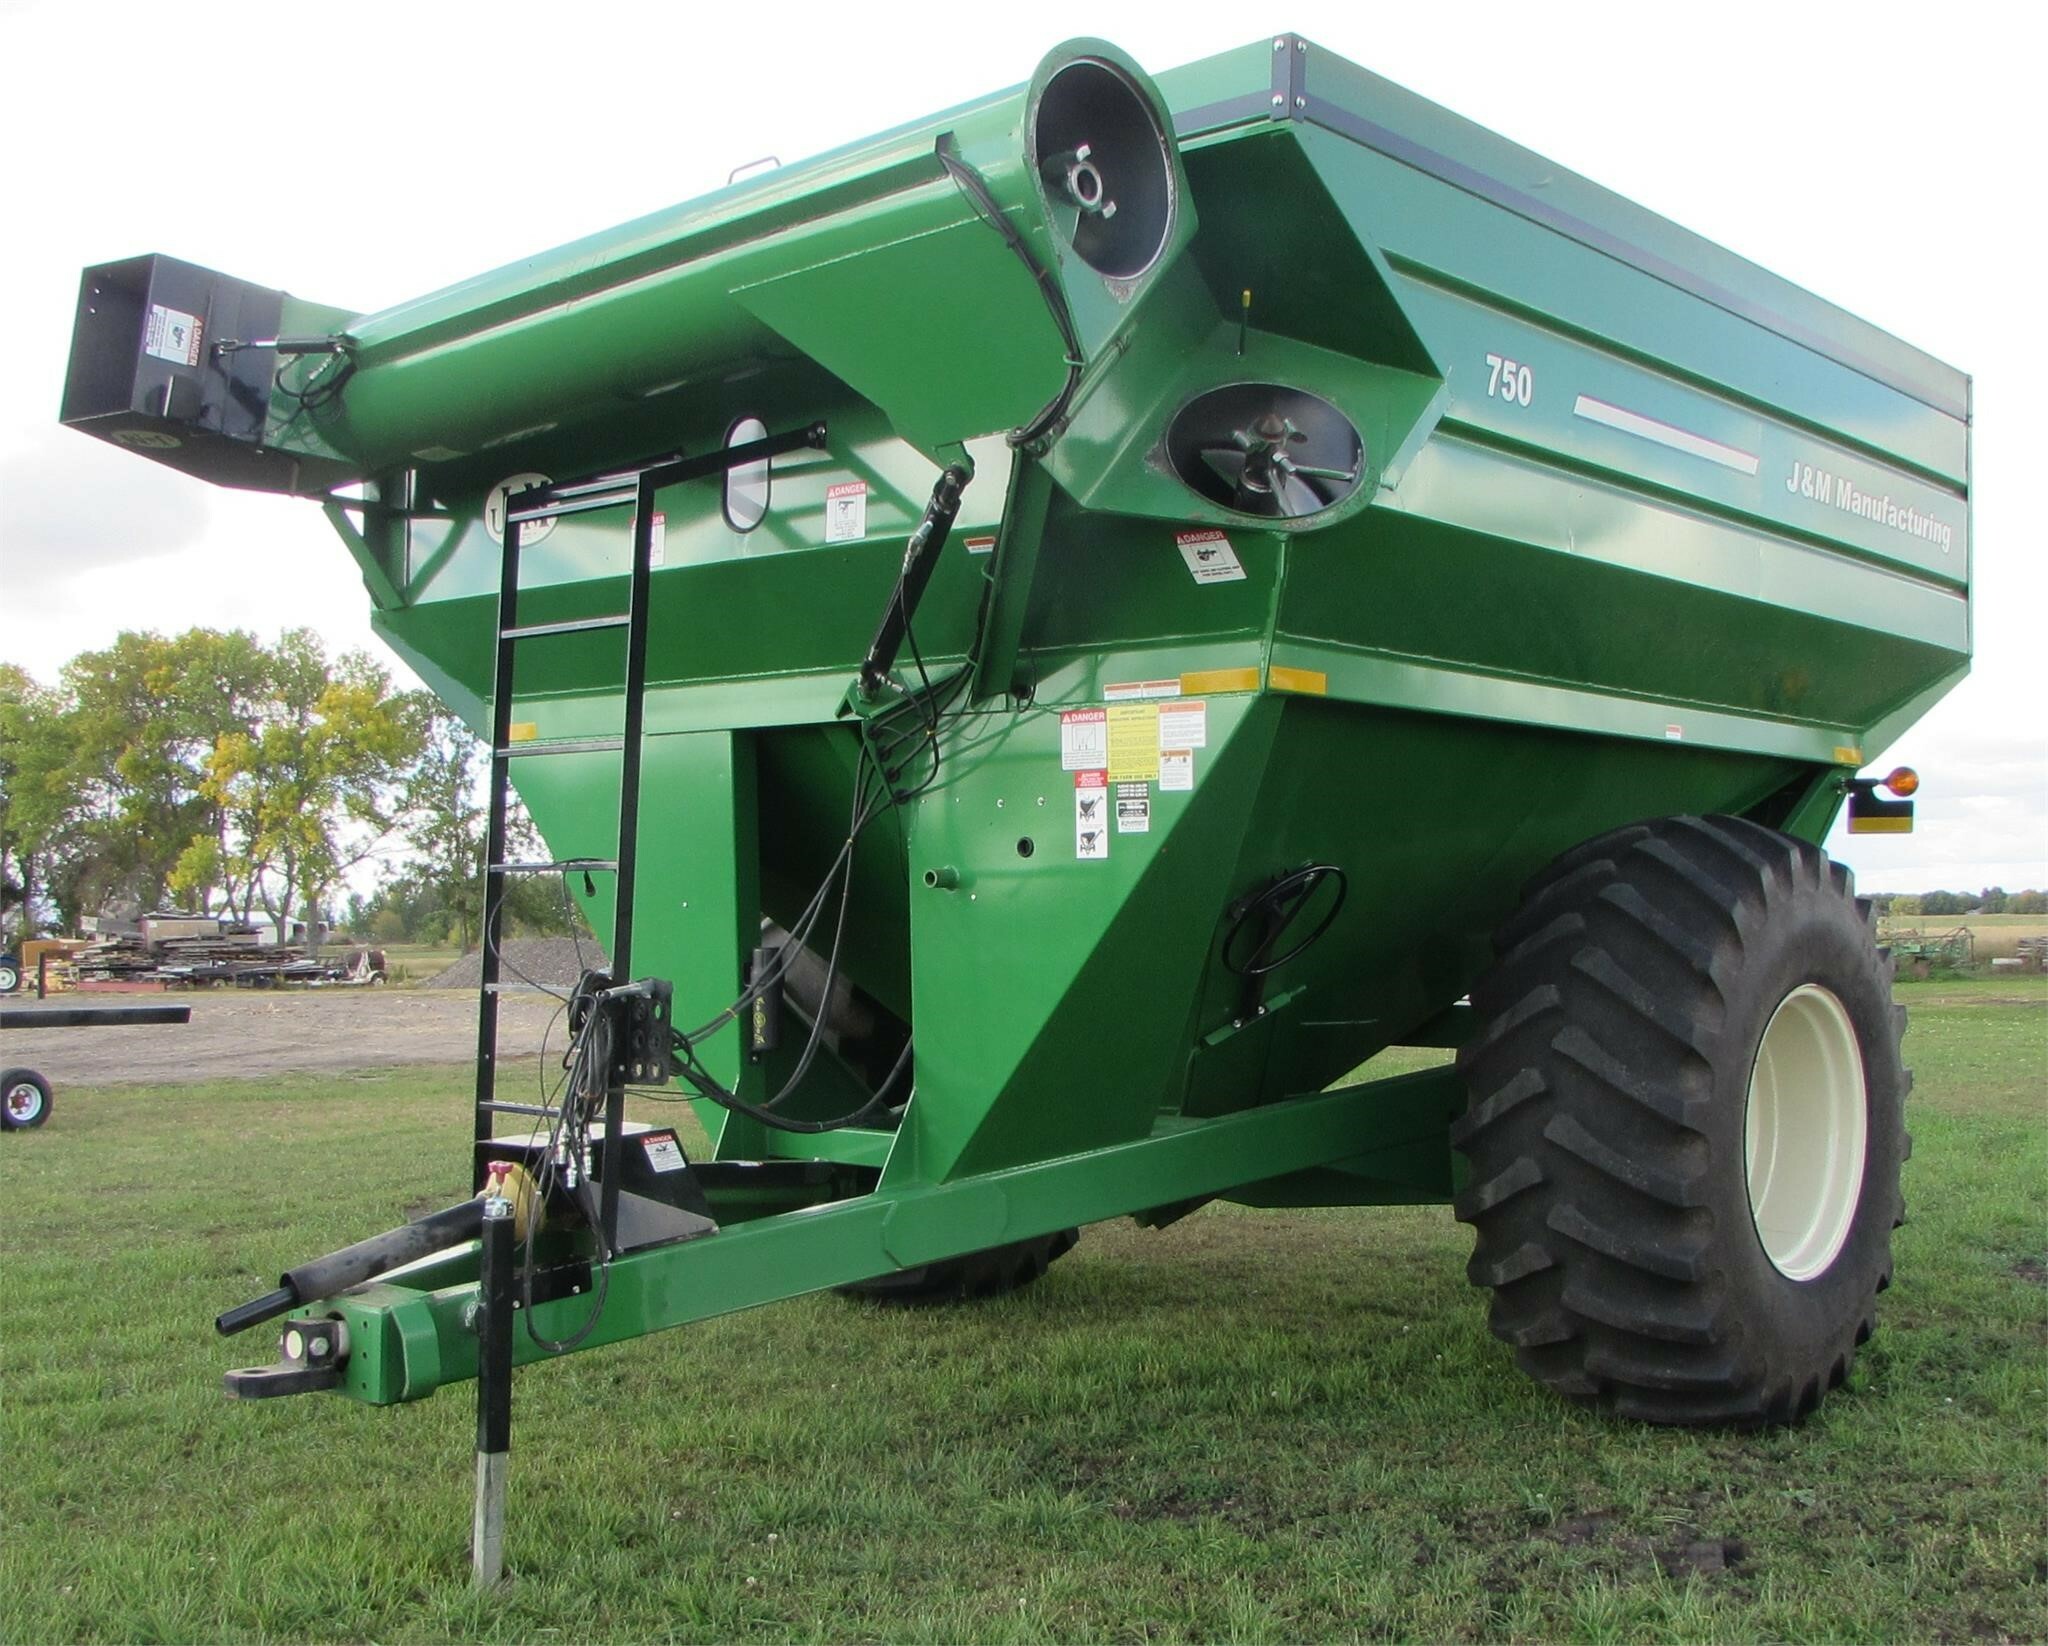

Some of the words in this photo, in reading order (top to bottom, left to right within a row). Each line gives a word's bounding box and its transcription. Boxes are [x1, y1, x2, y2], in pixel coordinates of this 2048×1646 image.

[188, 327, 203, 367] DANGER
[1485, 354, 1534, 409] 750
[834, 483, 866, 497] DANGER
[1786, 461, 1832, 506] J&M
[1836, 481, 1952, 555] Manufacturing
[1183, 530, 1224, 543] DANGER
[1071, 711, 1105, 722] DANGER
[650, 1134, 673, 1144] DANGER
